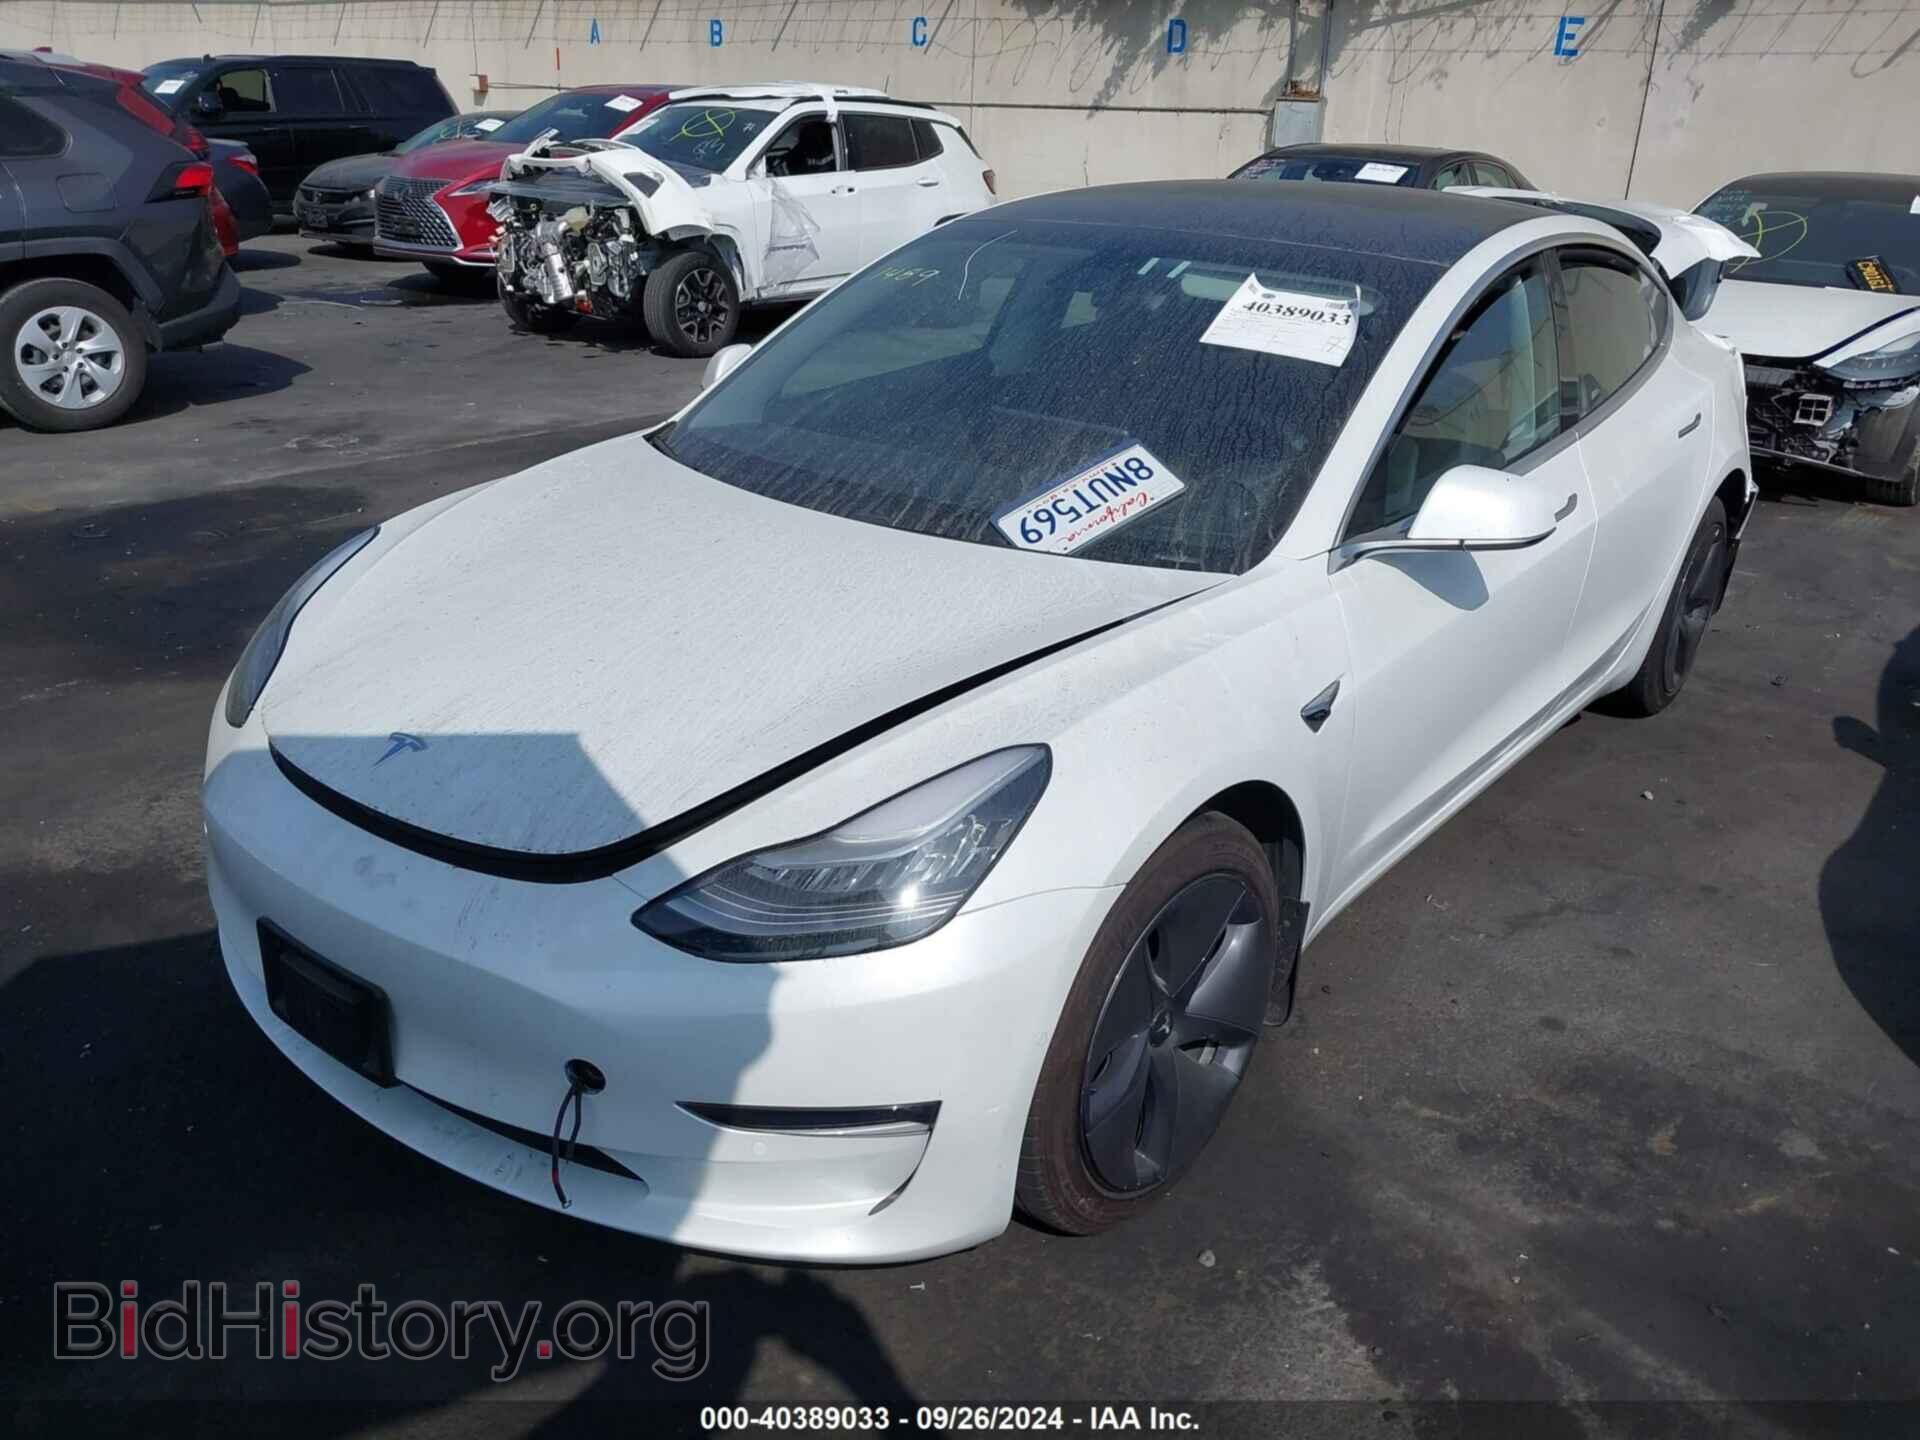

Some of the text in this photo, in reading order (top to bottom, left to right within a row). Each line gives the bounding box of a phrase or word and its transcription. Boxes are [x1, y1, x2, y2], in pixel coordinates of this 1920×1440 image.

[590, 18, 601, 45] A
[710, 19, 722, 47] B
[913, 16, 927, 46] C
[1168, 19, 1186, 53] D
[1553, 16, 1585, 56] E
[1243, 300, 1352, 326] 40389033
[1020, 457, 1154, 544] 8NUT569
[1055, 491, 1148, 543] California
